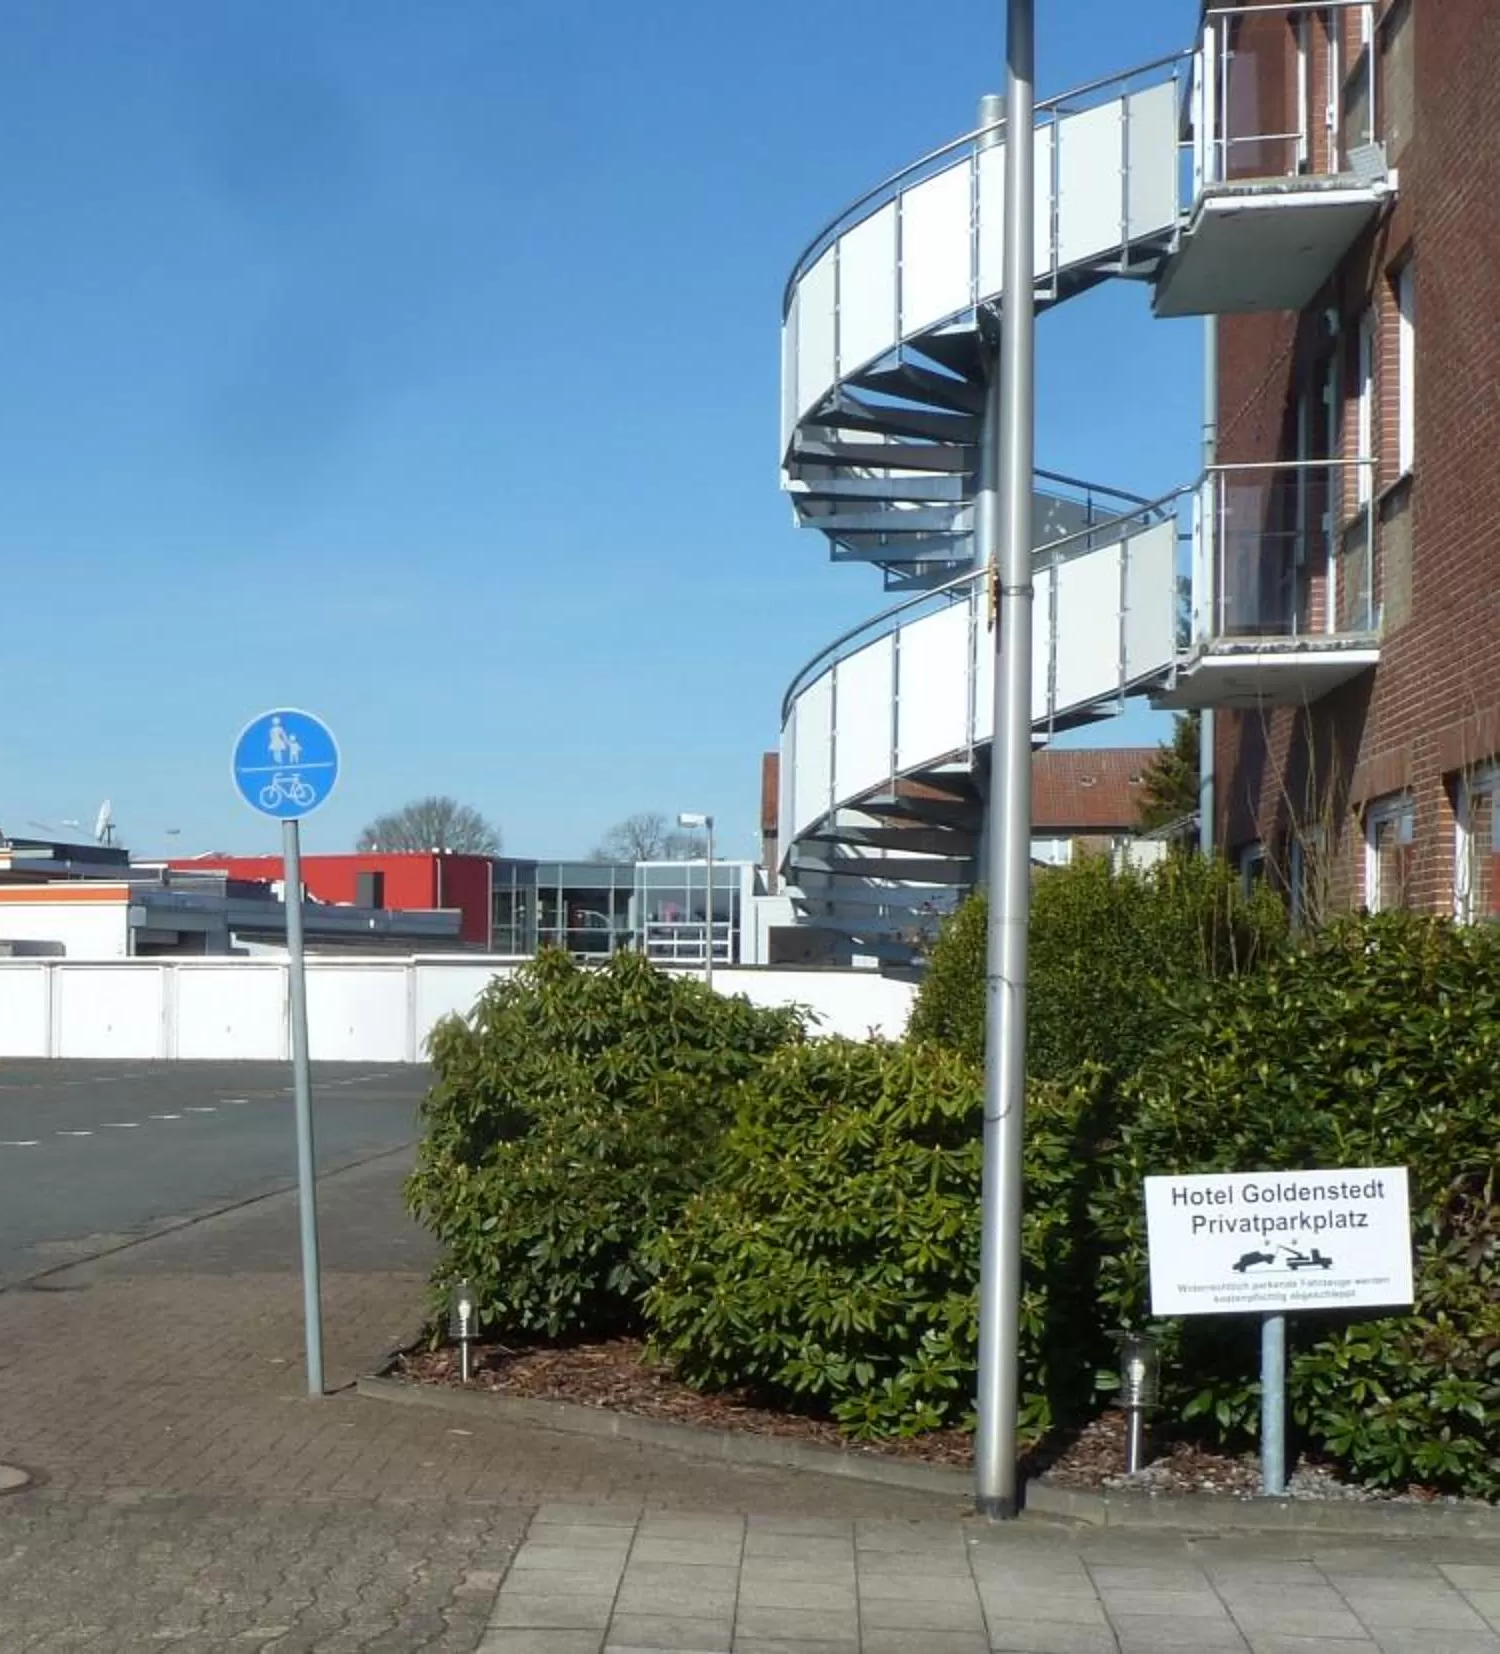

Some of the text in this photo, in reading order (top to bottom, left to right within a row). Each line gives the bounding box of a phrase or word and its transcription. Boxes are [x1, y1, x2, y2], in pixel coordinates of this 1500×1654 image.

[1171, 1179, 1385, 1206] Hotel Goldenstedt
[1192, 1210, 1369, 1236] Privatparkplatz
